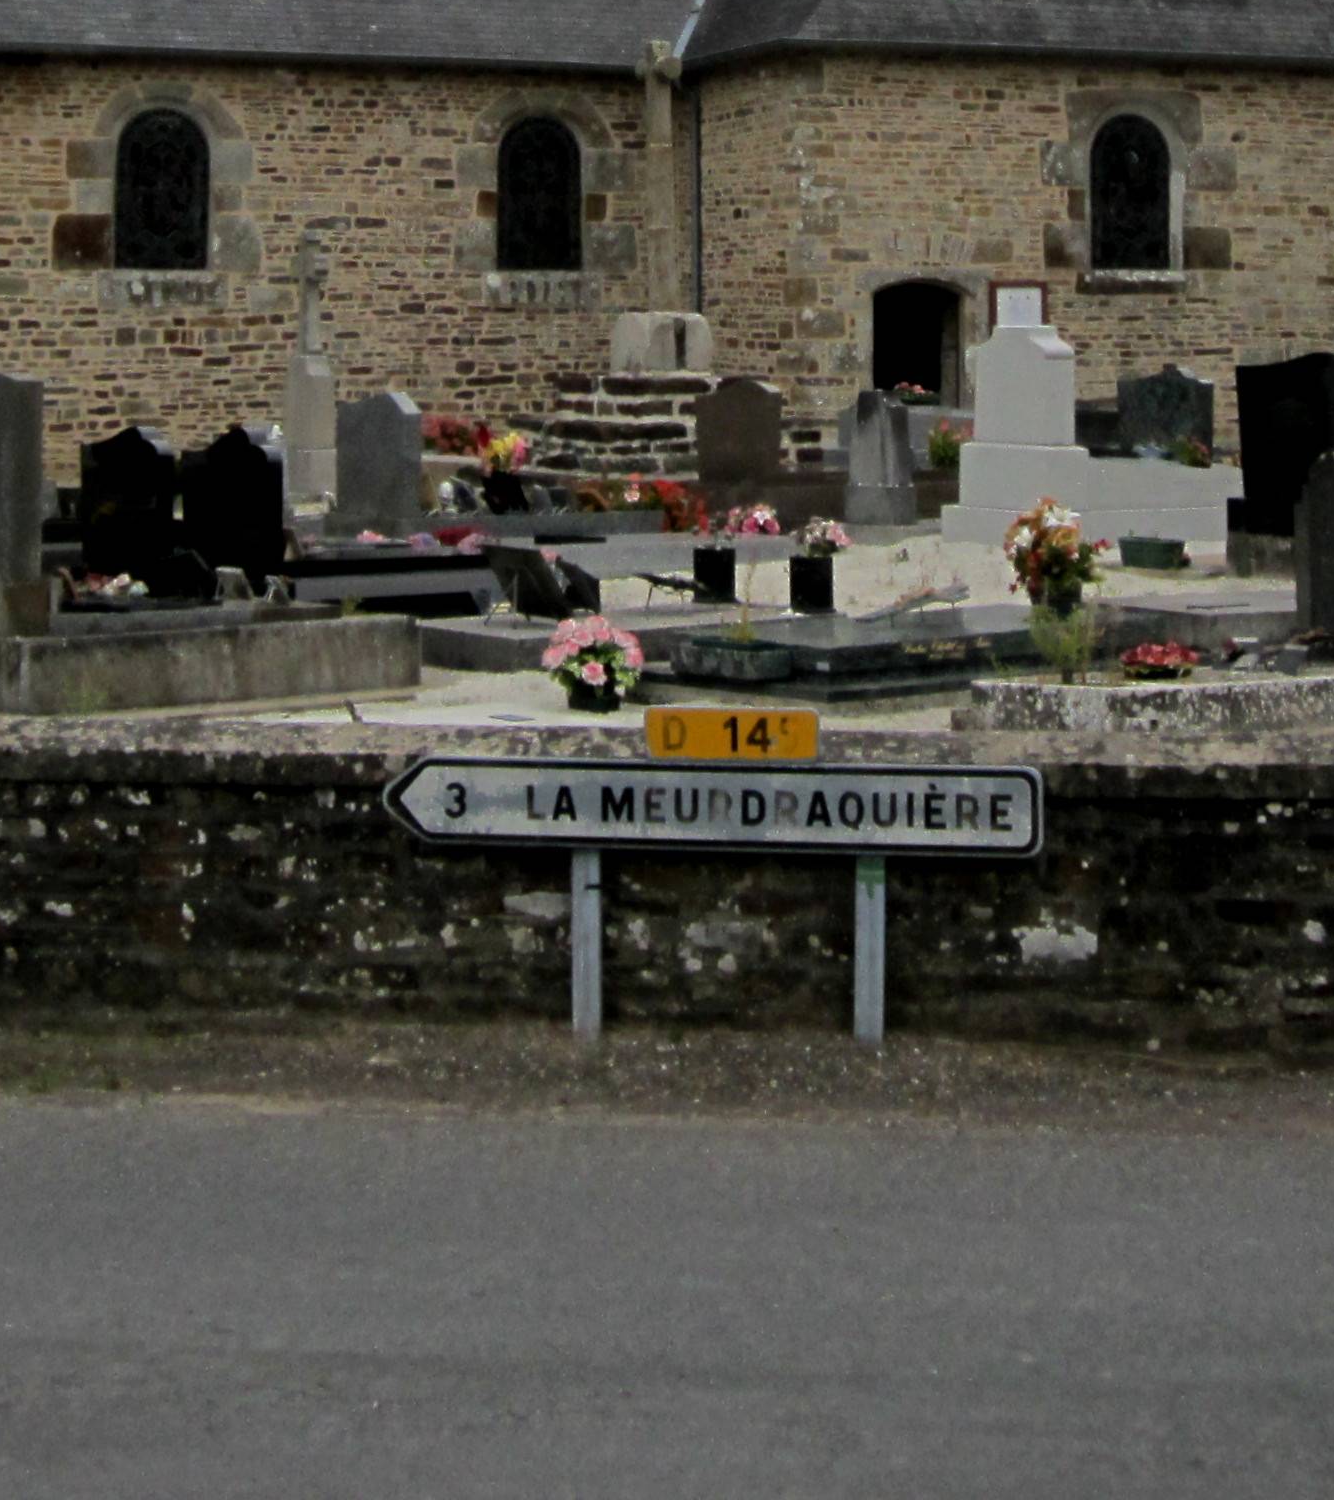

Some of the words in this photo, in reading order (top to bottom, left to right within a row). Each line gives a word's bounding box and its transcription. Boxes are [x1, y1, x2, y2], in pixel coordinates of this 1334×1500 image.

[662, 715, 687, 751] D
[444, 782, 467, 817] 3
[526, 784, 578, 821] LA
[600, 782, 1014, 831] MEURDRAQUIÈRE
